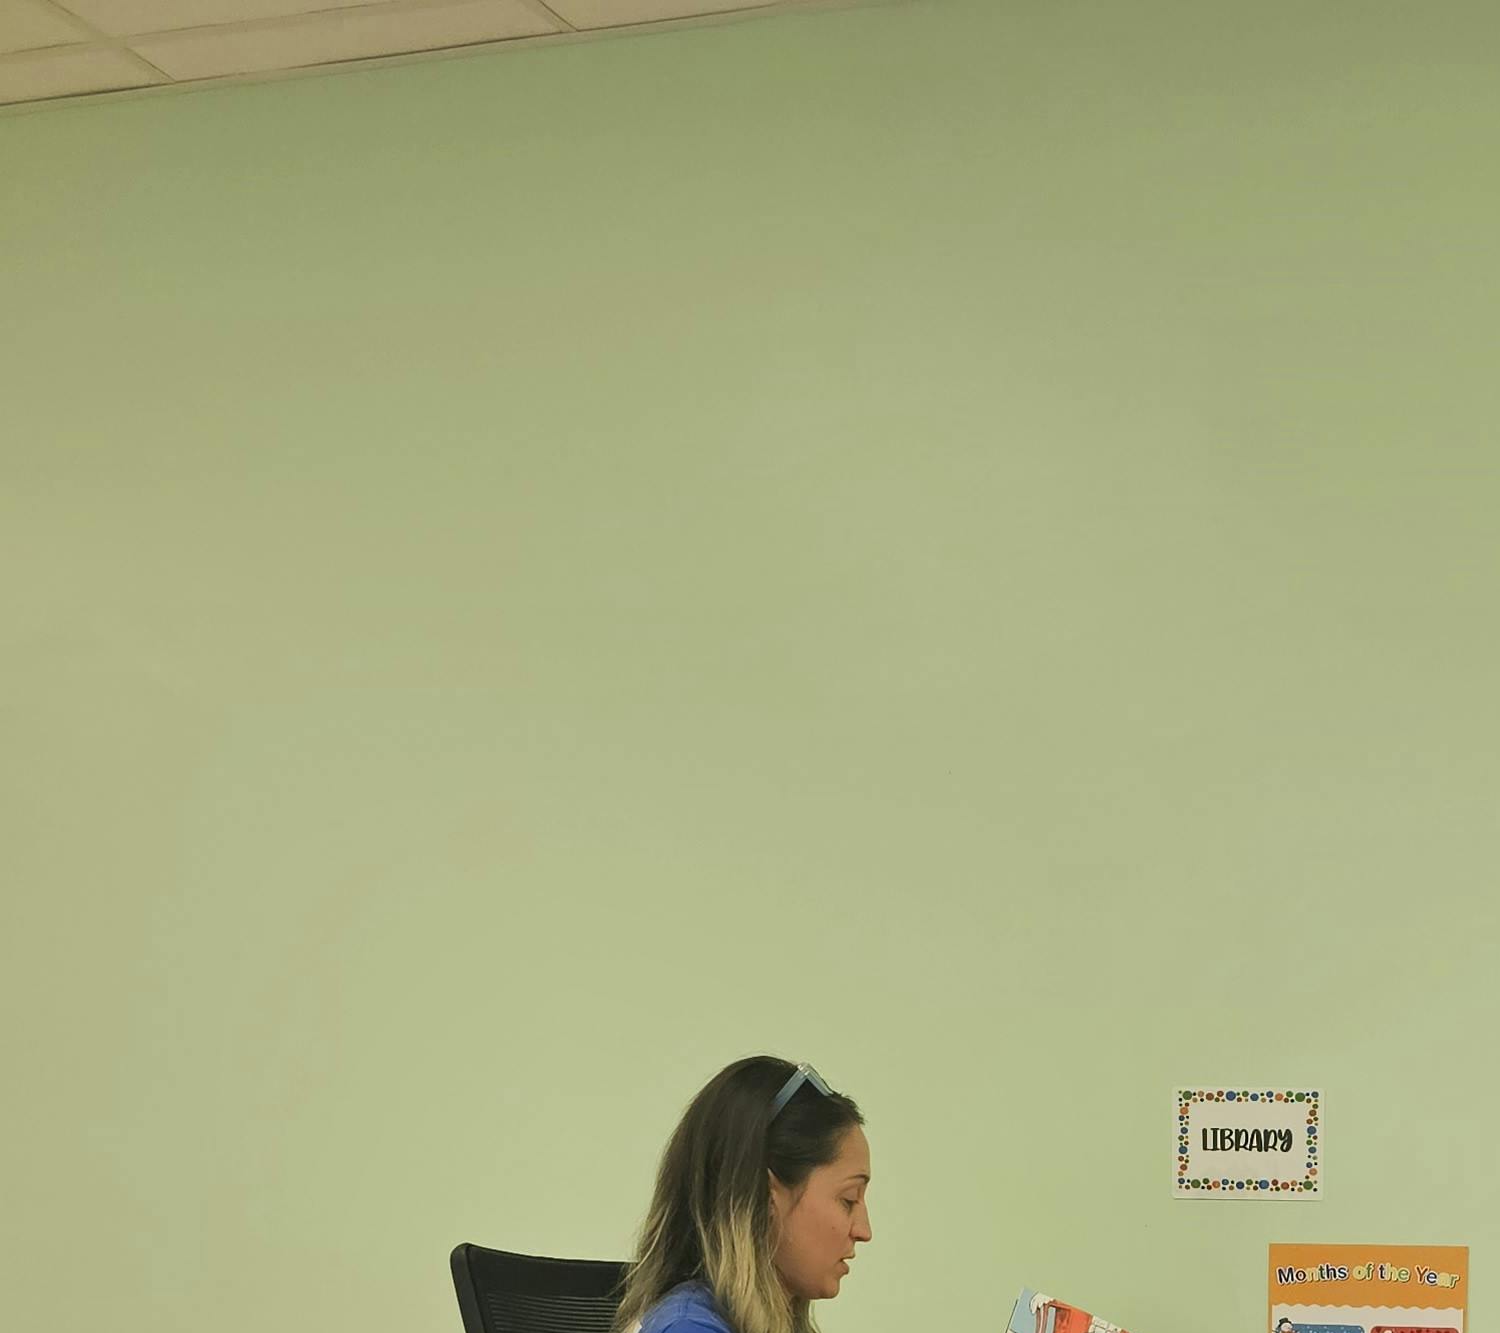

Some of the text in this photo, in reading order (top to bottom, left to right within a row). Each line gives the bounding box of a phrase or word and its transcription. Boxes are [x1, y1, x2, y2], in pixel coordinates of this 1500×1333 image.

[1202, 1127, 1293, 1152] LIBRARY
[1276, 1261, 1459, 1288] Months of the Year
